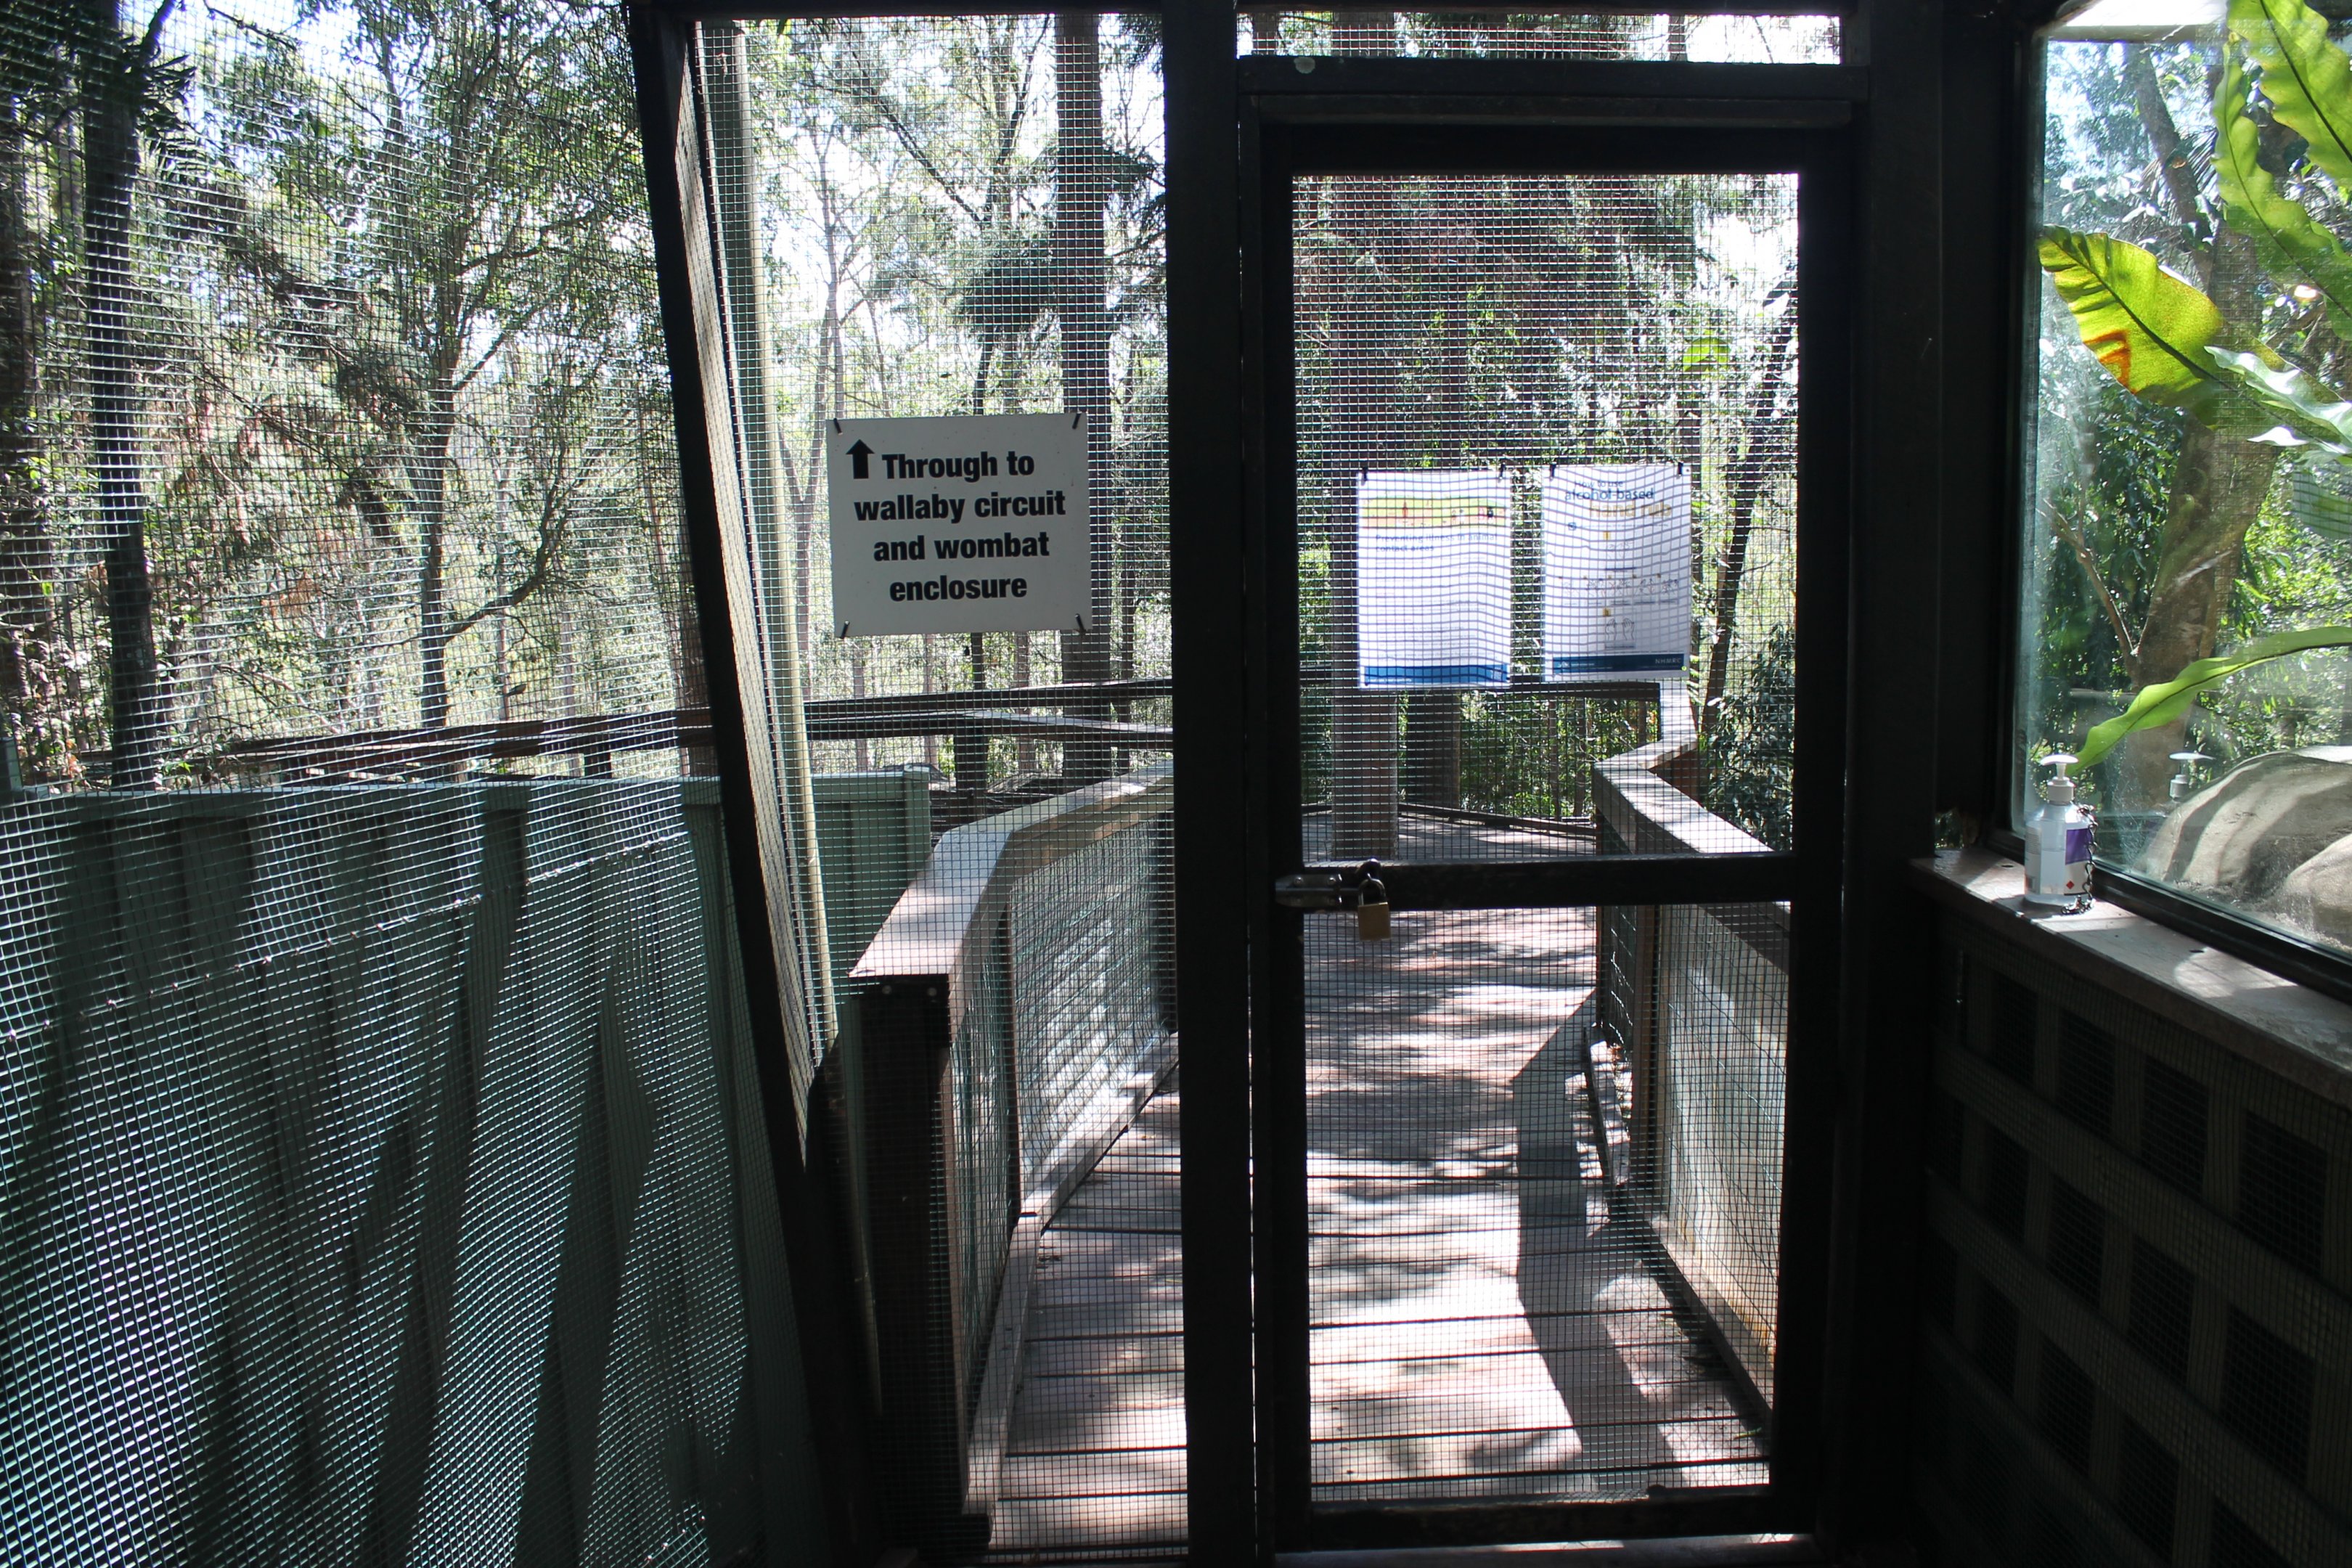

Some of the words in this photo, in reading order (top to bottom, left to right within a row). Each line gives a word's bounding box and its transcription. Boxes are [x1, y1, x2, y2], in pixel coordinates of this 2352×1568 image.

[881, 452, 998, 483] Through
[1006, 451, 1035, 475] to
[854, 494, 965, 524] wallaby
[974, 490, 1066, 518] circuit
[1564, 488, 1654, 501] alcohol-based
[1590, 499, 1637, 518] hand
[1641, 499, 1672, 518] rub
[873, 534, 926, 562] and
[934, 531, 1050, 560] wombat
[889, 575, 1028, 602] enclosure
